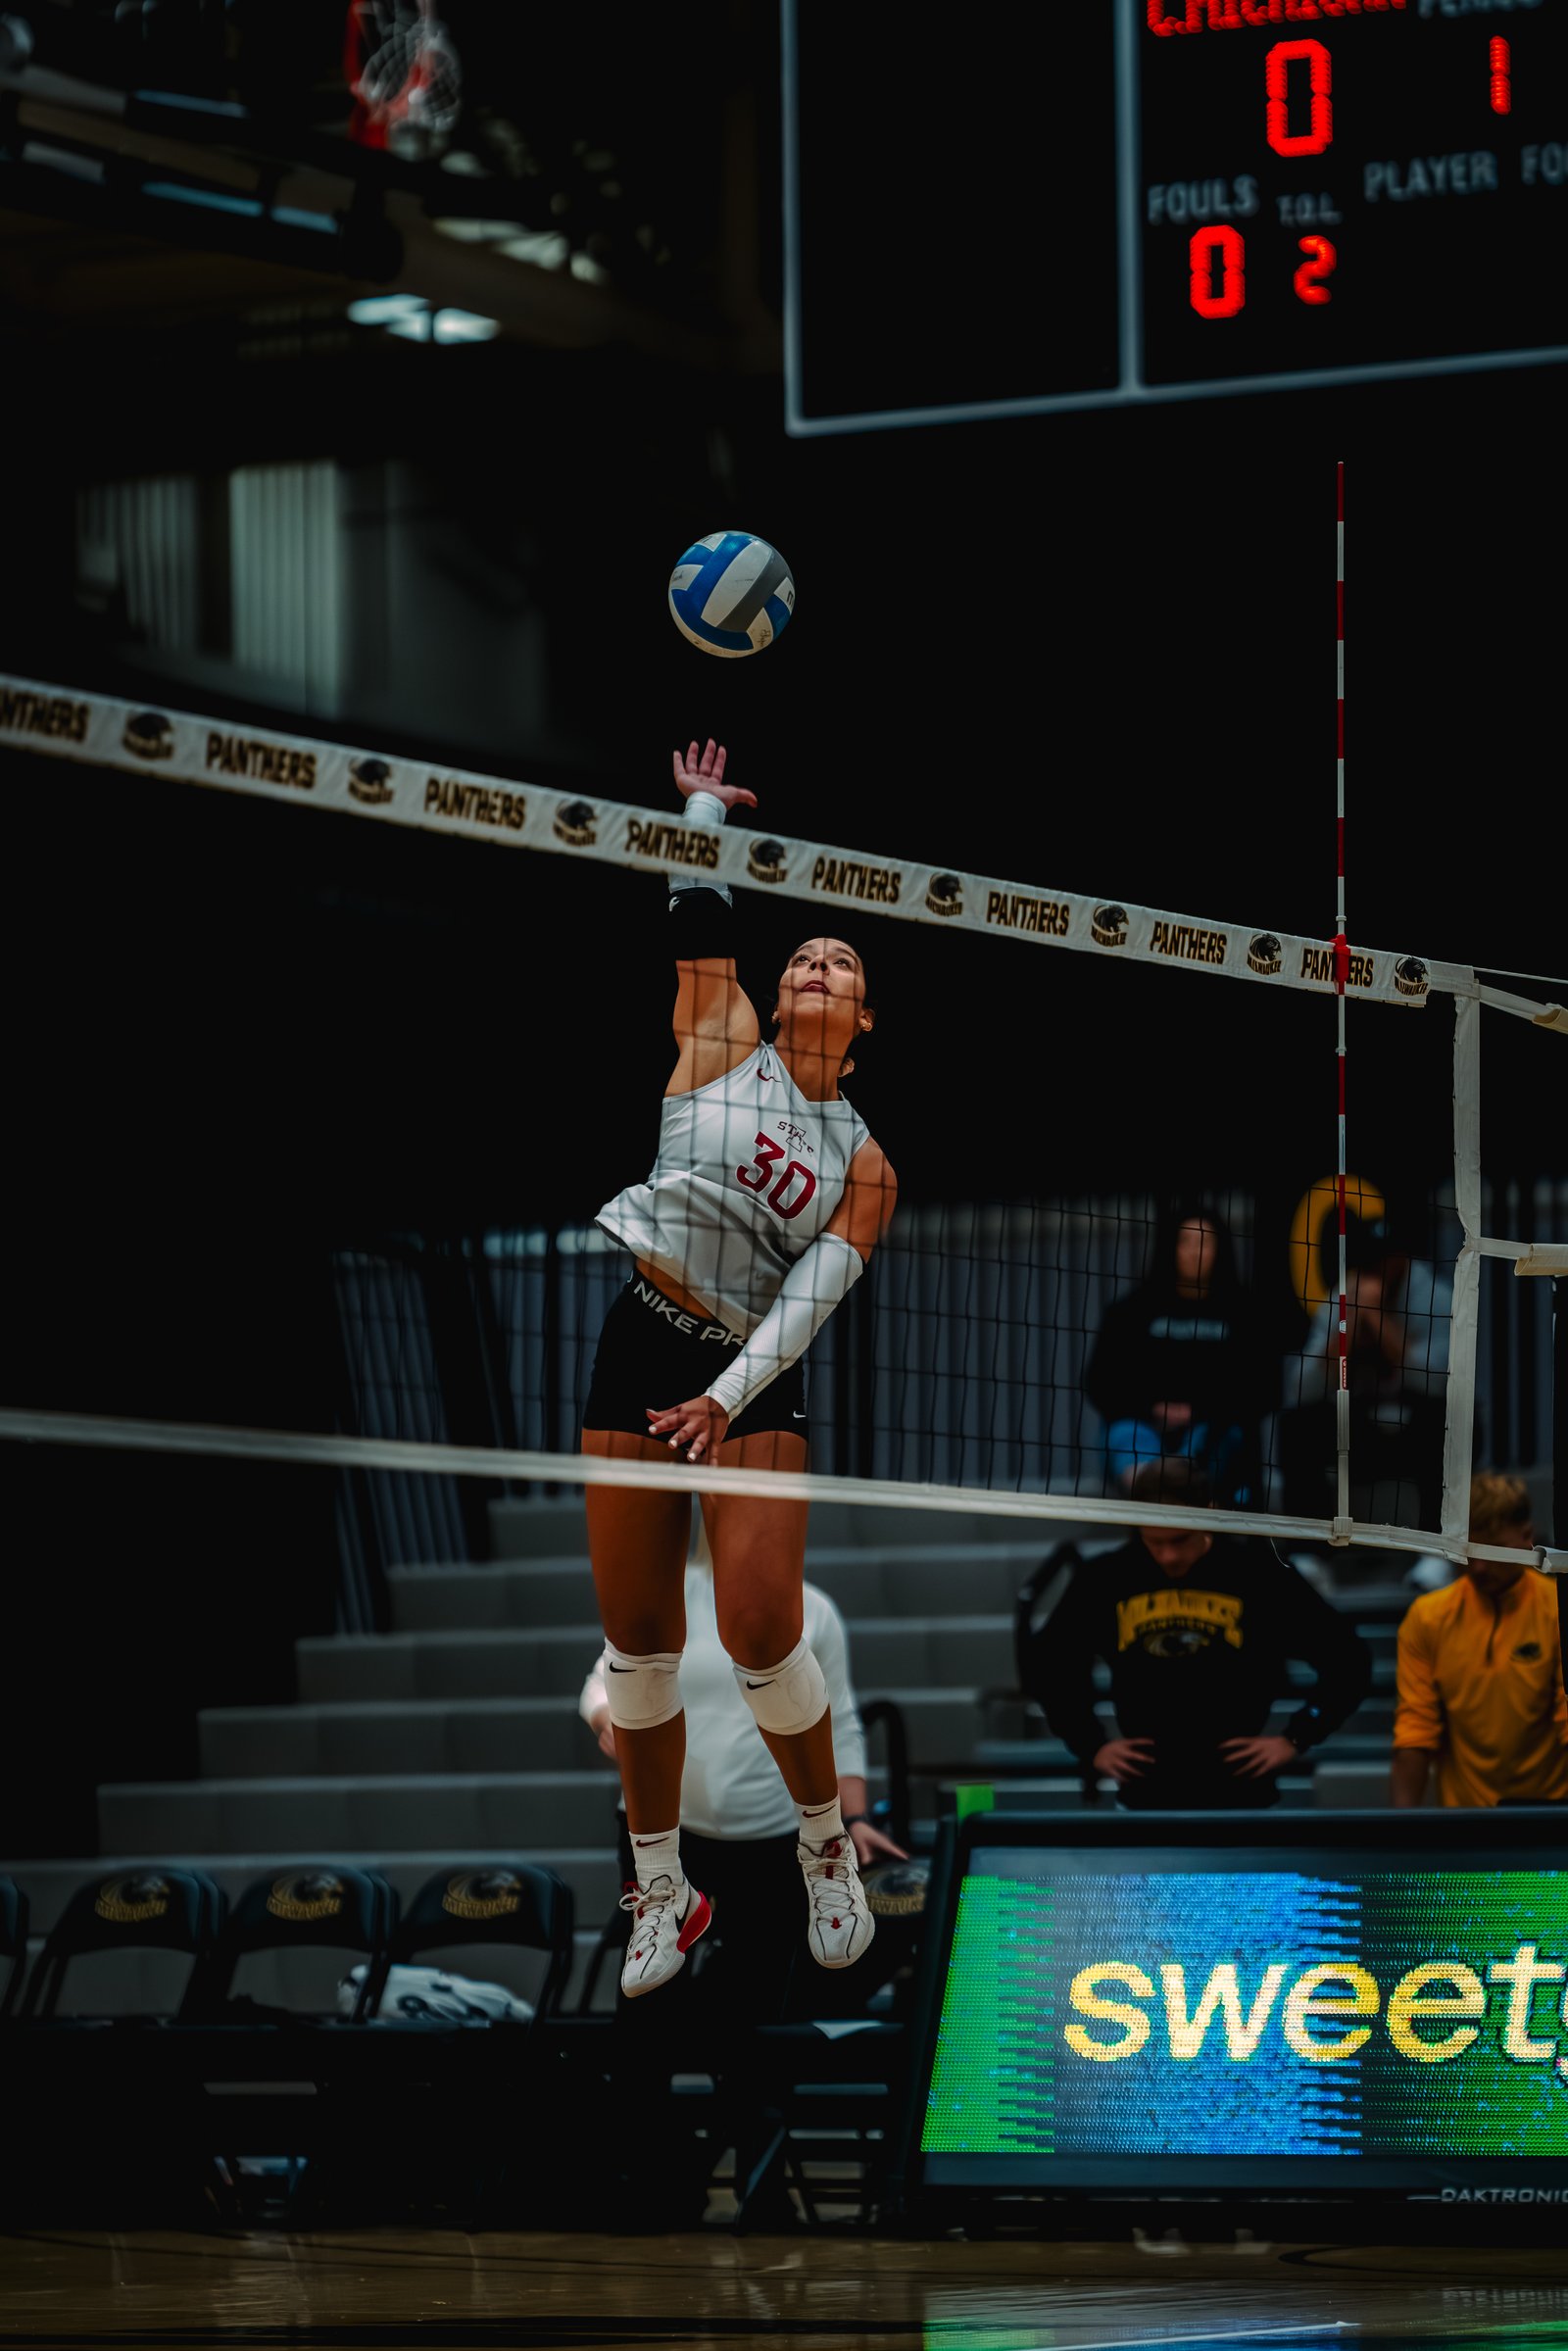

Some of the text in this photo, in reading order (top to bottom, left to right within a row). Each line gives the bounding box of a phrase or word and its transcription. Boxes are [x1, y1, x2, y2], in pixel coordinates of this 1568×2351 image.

[1266, 39, 1333, 157] 0
[1490, 36, 1511, 115] 1
[1147, 173, 1260, 226] FOULS
[1363, 141, 1568, 203] PLAYER FO
[1190, 225, 1246, 319] 0
[1294, 235, 1337, 305] 2
[206, 731, 317, 790] PANTHERS
[424, 777, 526, 830] PANTHERS
[625, 820, 720, 869] PANTHERS
[811, 855, 901, 904] PANTHERS
[986, 891, 1070, 937] PANTHERS
[1150, 920, 1227, 964] PANTHERS
[735, 1130, 817, 1220] 30
[633, 1280, 699, 1335] NIKE
[1063, 1945, 1568, 2076] sweet
